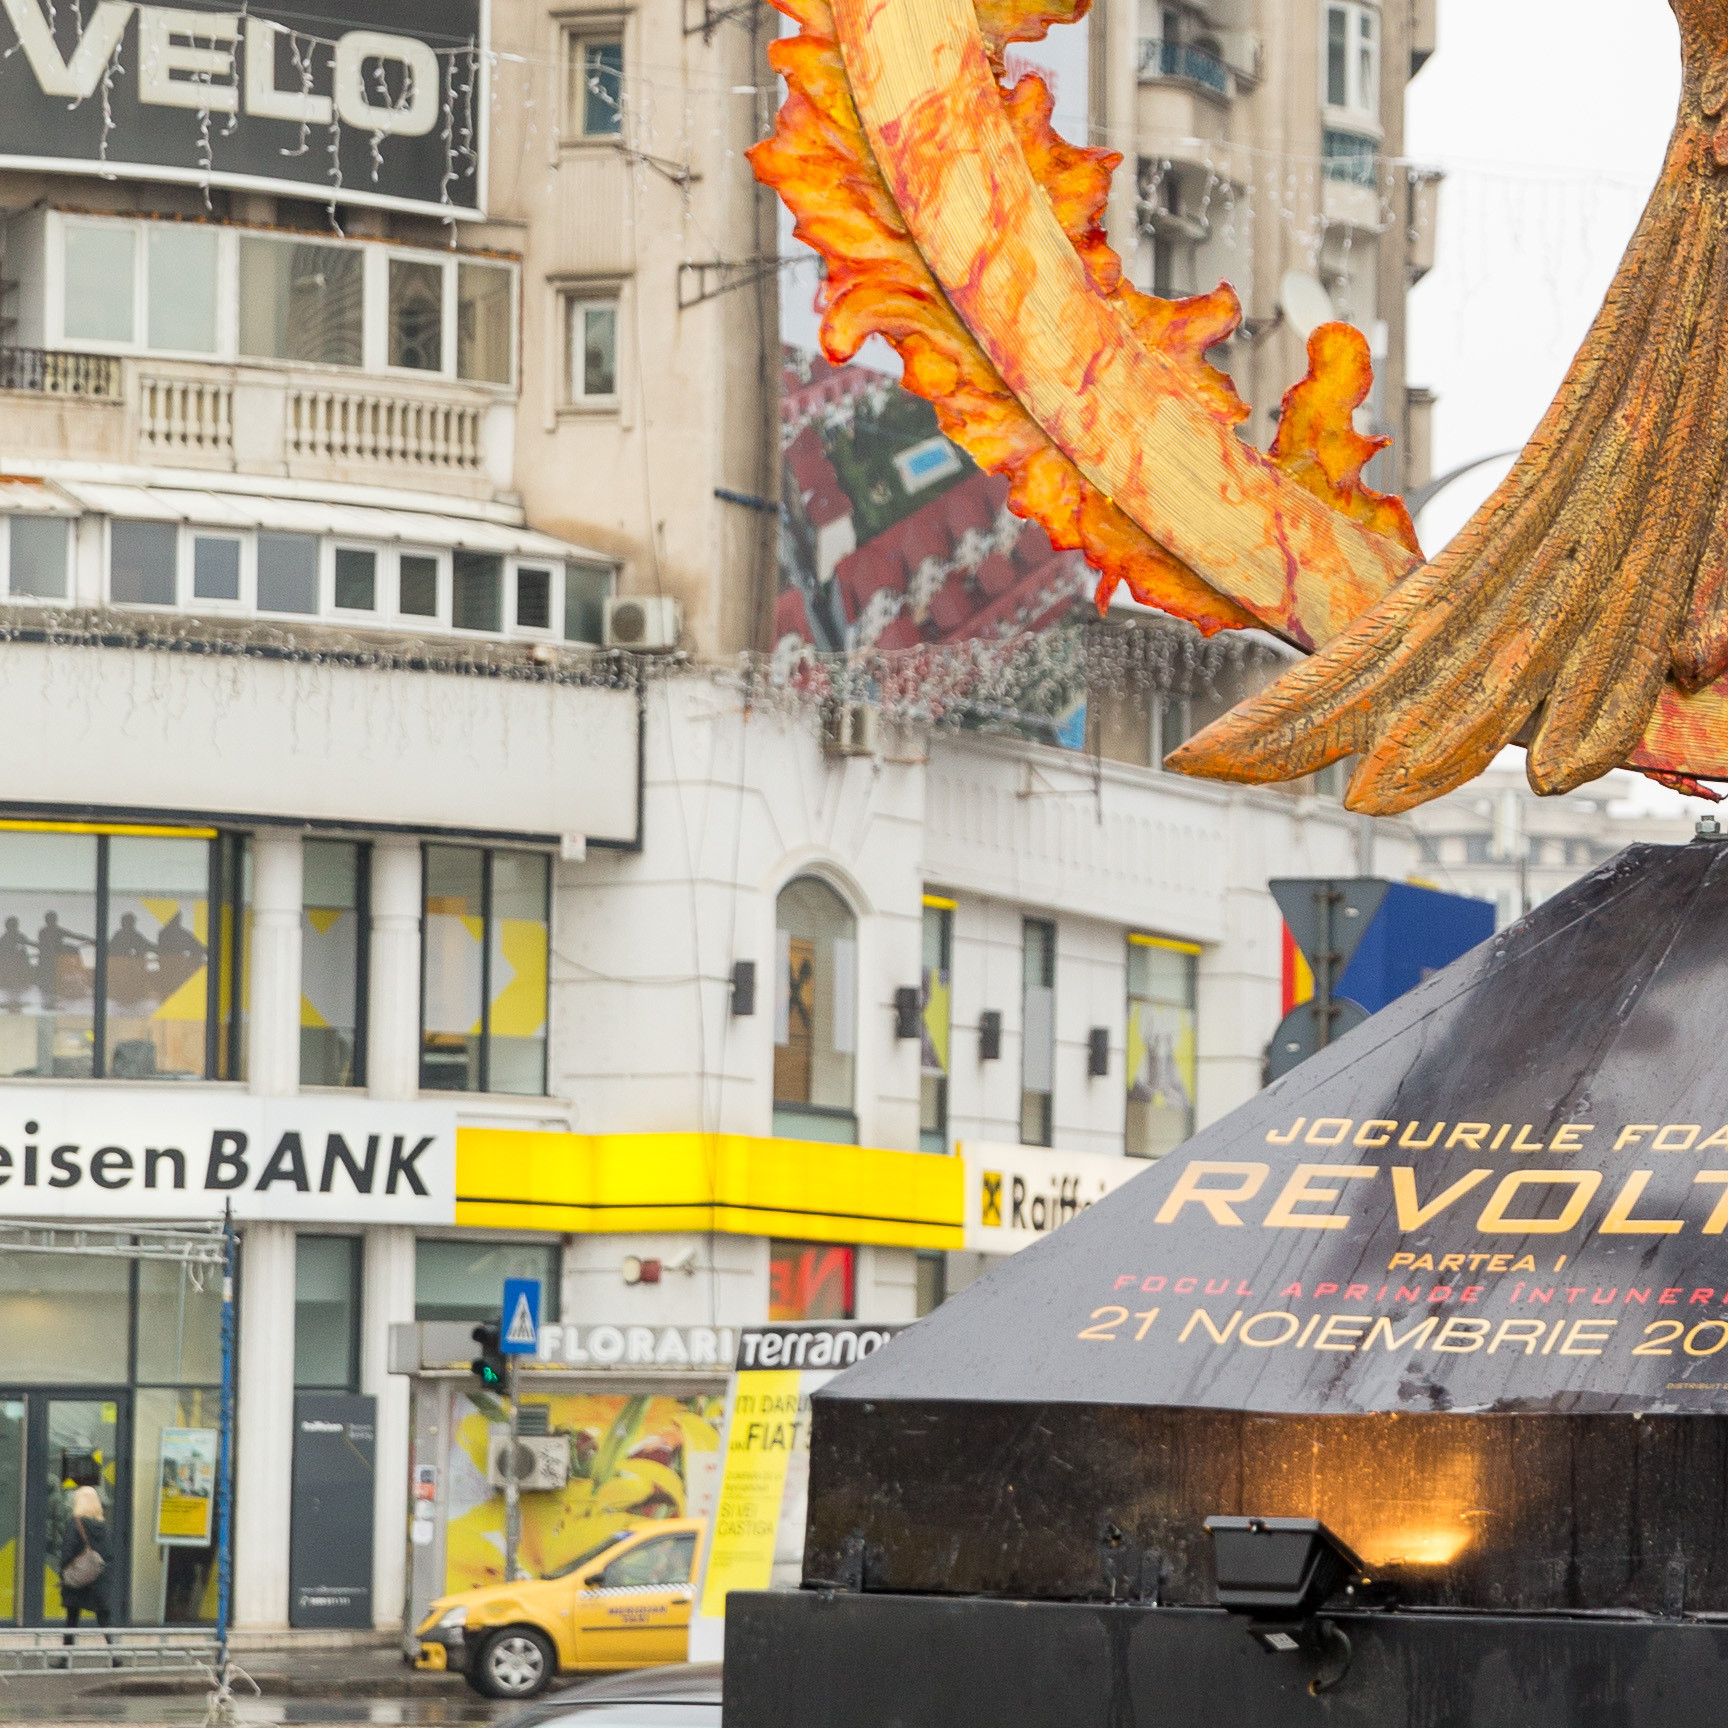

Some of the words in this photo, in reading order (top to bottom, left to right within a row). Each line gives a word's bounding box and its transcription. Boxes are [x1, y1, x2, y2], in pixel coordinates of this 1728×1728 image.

[1266, 1116, 1595, 1150] JOCURILE
[0, 1119, 187, 1190] isen
[204, 1128, 437, 1197] BANK
[1387, 1252, 1537, 1272] PARTEA
[1552, 1254, 1568, 1273] I
[1112, 1275, 1254, 1297] FOCUL
[1280, 1282, 1485, 1303] APRINDE
[538, 1325, 733, 1364] FLORARI
[1077, 1305, 1161, 1341] 21
[1177, 1308, 1619, 1356] NOIEMBRIE
[746, 1421, 803, 1452] FIAT
